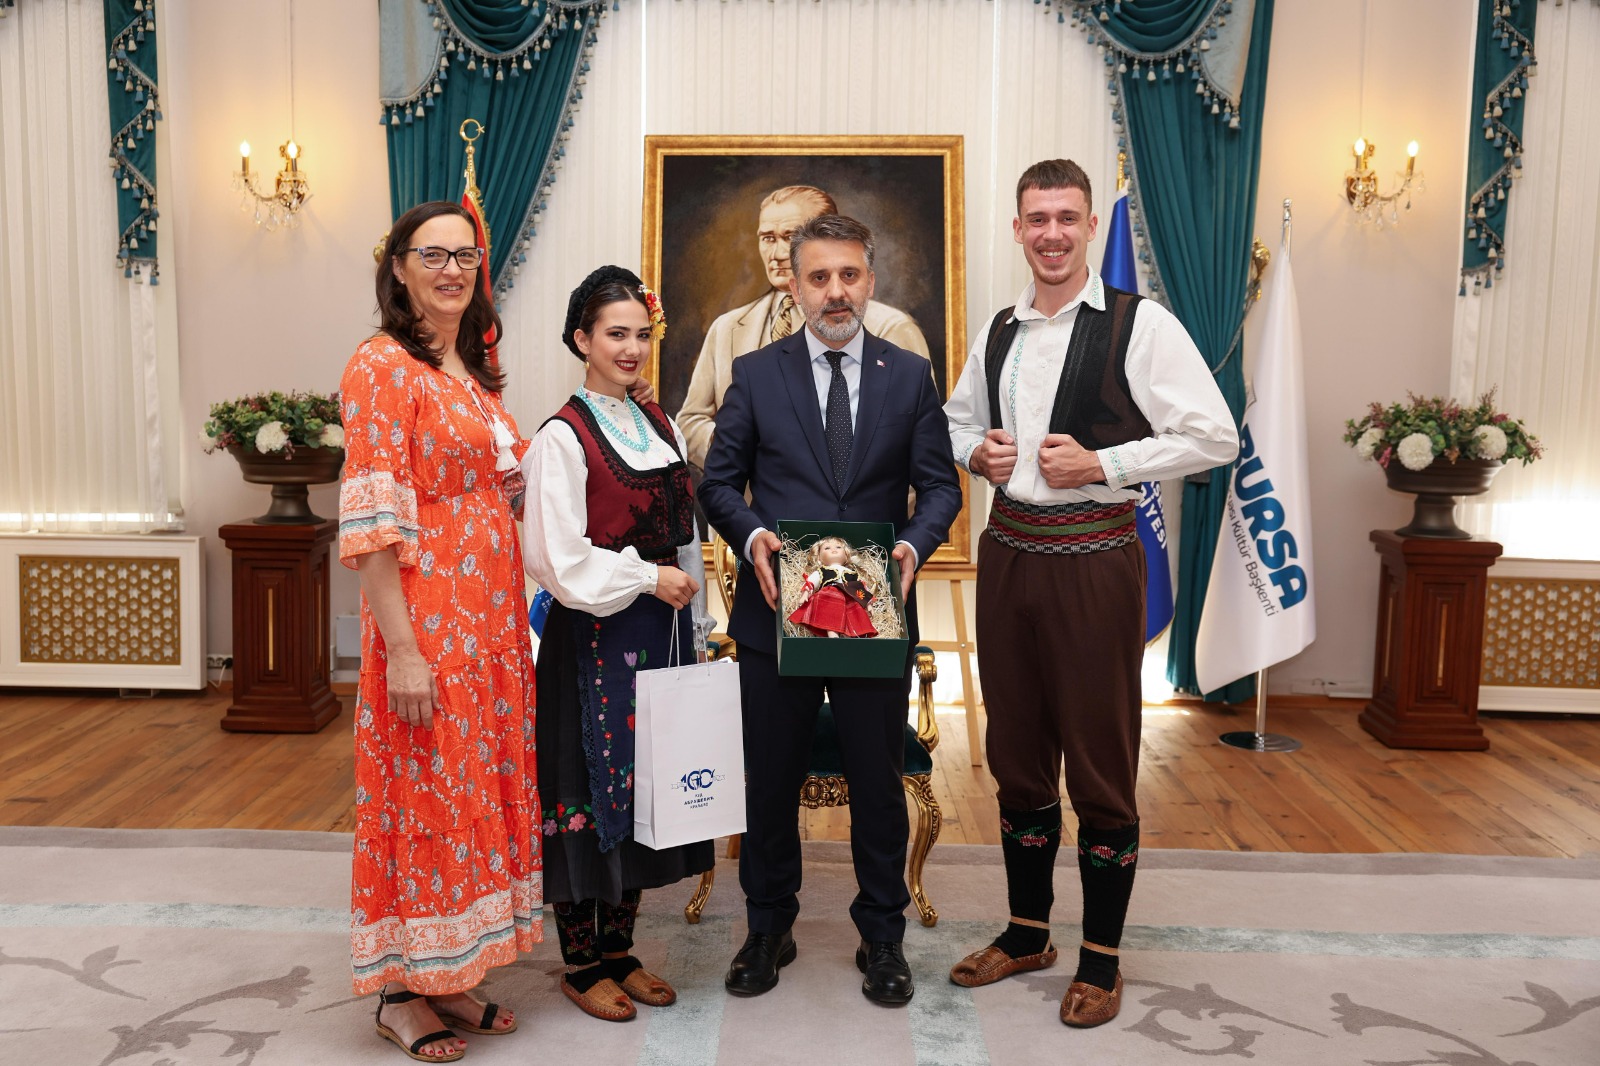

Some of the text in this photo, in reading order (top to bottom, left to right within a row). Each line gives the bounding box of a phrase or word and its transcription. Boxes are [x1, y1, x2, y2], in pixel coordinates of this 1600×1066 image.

[1231, 520, 1252, 559] Kültür
[1245, 560, 1280, 617] Başkenti
[1234, 423, 1308, 610] BURSA
